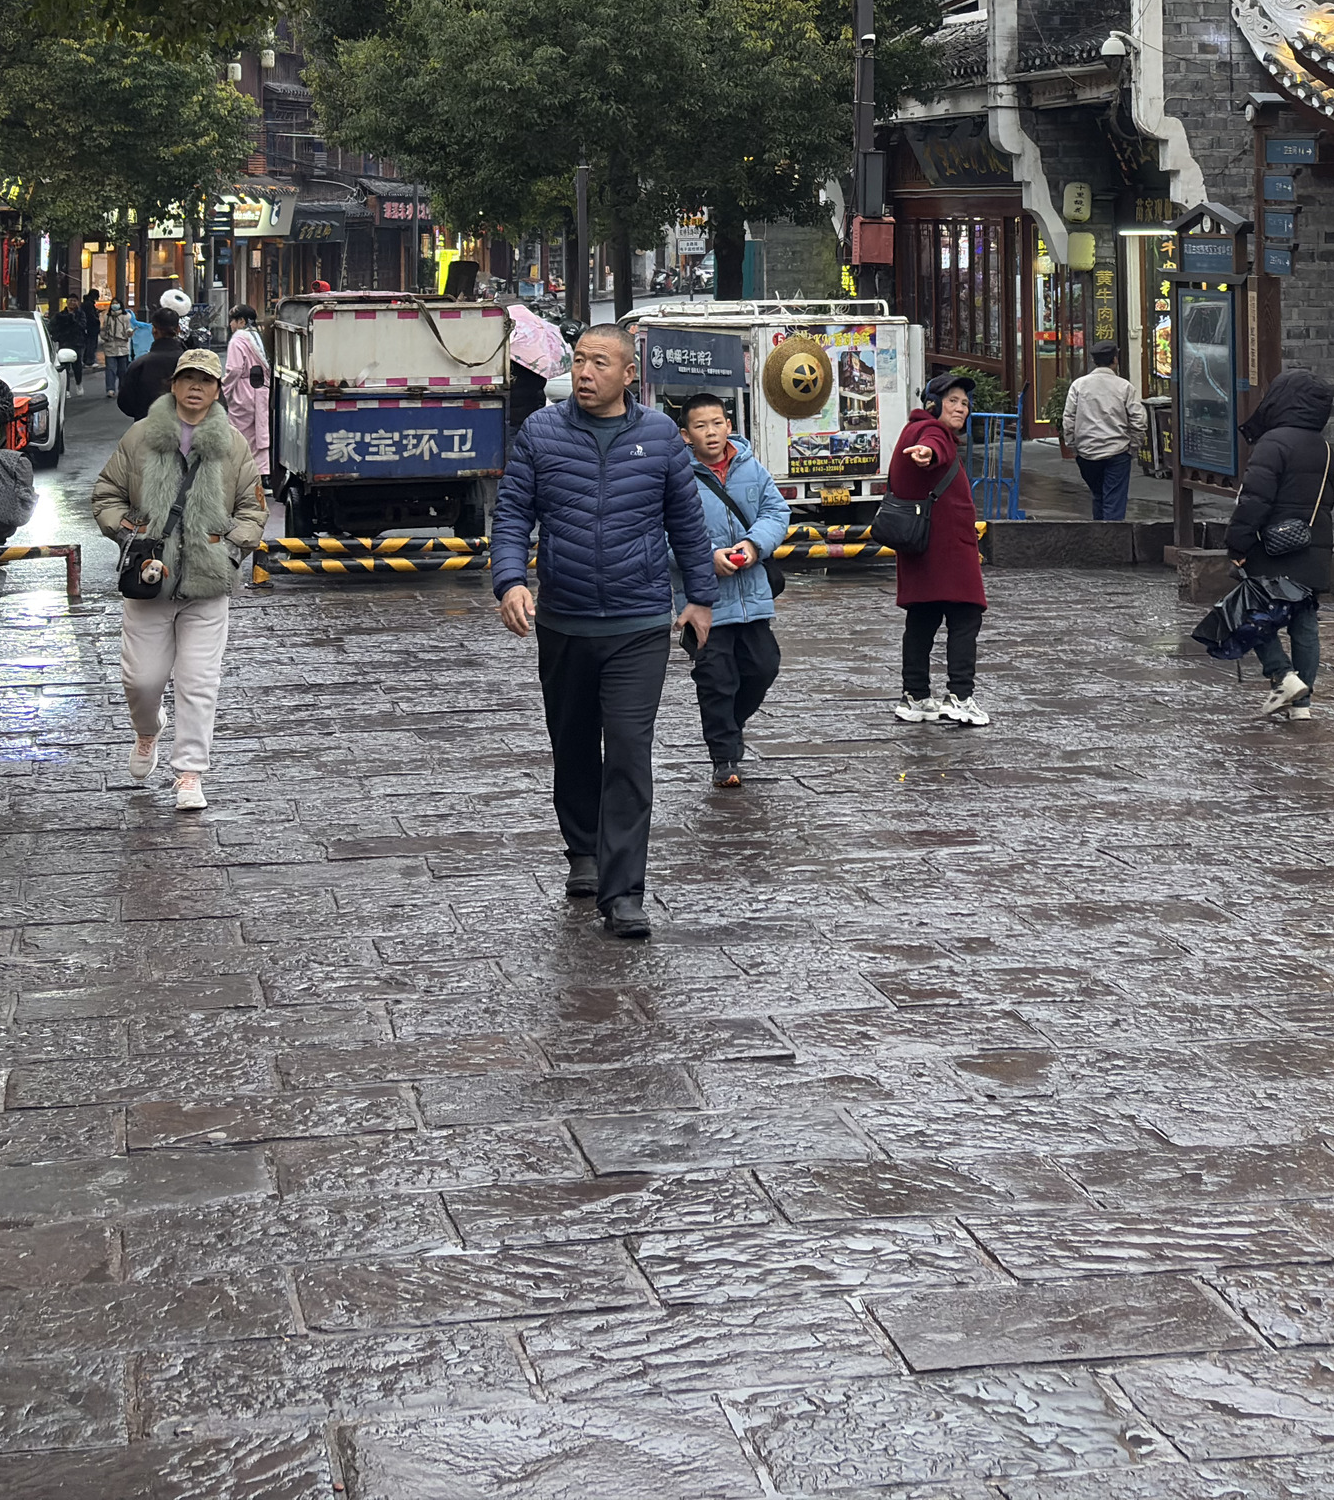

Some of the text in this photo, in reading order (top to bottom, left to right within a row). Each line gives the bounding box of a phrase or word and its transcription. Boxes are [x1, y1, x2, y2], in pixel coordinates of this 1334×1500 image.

[1095, 269, 1115, 340] 黄牛肉粉
[324, 428, 476, 463] 家宝环卫
